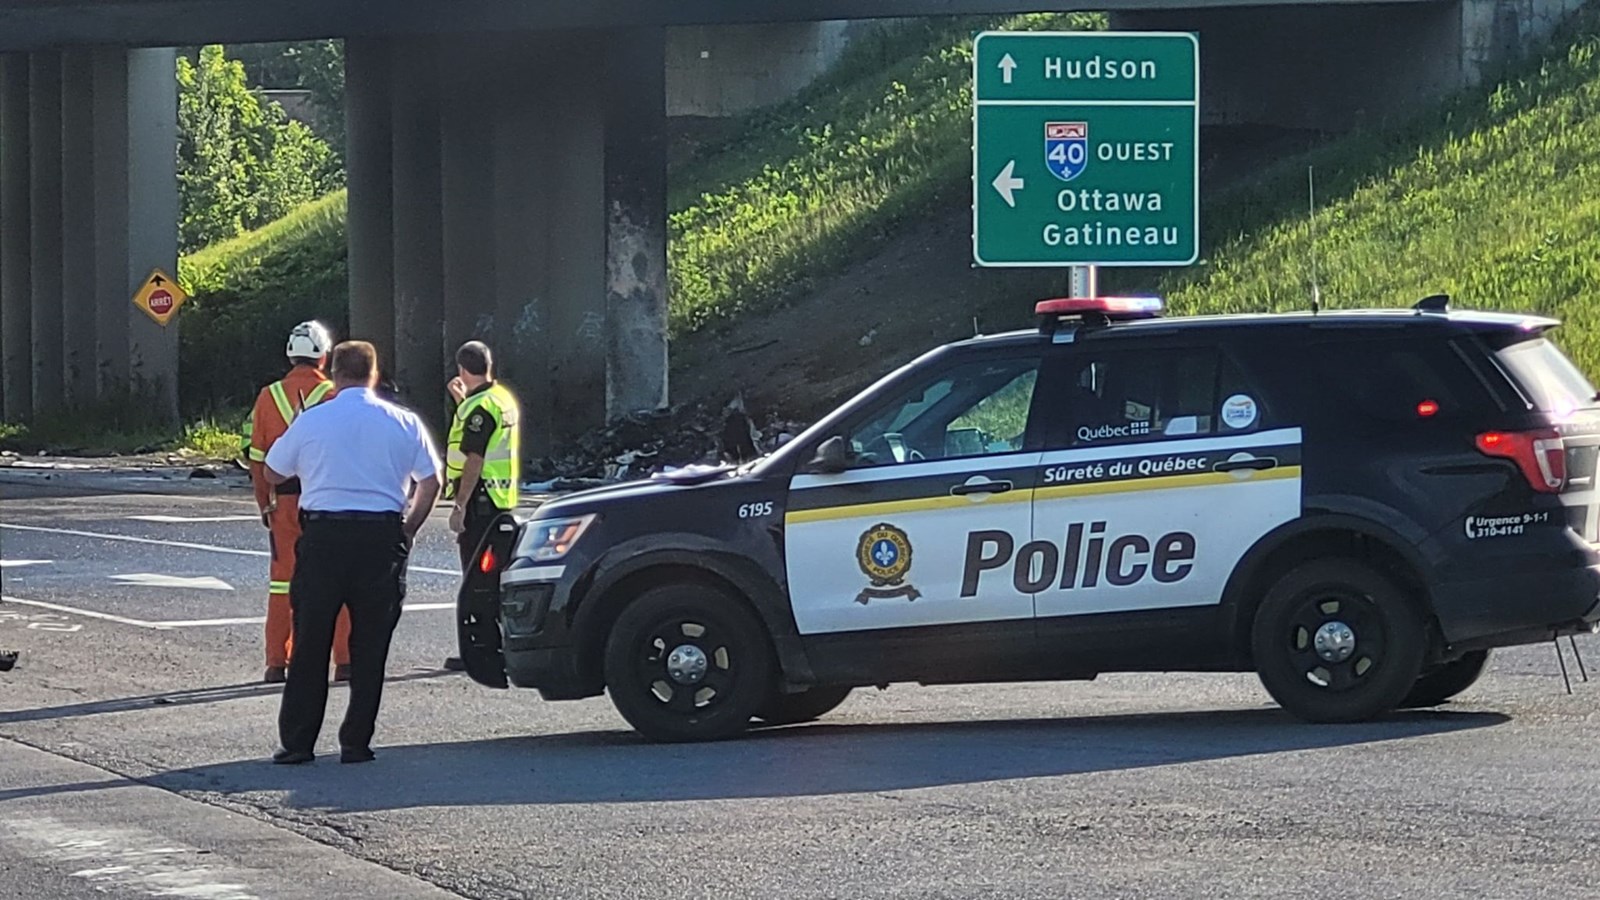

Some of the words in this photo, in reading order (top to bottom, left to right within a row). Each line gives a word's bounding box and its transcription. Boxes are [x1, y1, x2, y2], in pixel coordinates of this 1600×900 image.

[1044, 55, 1157, 80] Hudson
[1048, 142, 1085, 165] 40
[1096, 142, 1174, 161] OUEST
[1057, 189, 1162, 212] Ottawa
[1043, 221, 1179, 246] Gatineau
[1077, 424, 1130, 441] Québec
[1044, 464, 1104, 483] Sûreté
[1108, 461, 1134, 476] du
[1137, 455, 1207, 475] Québec
[738, 501, 773, 518] 6195
[1475, 515, 1521, 528] Urgence
[1523, 512, 1549, 524] 9-1-1
[1476, 525, 1524, 537] 310-4141
[959, 520, 1197, 599] Police
